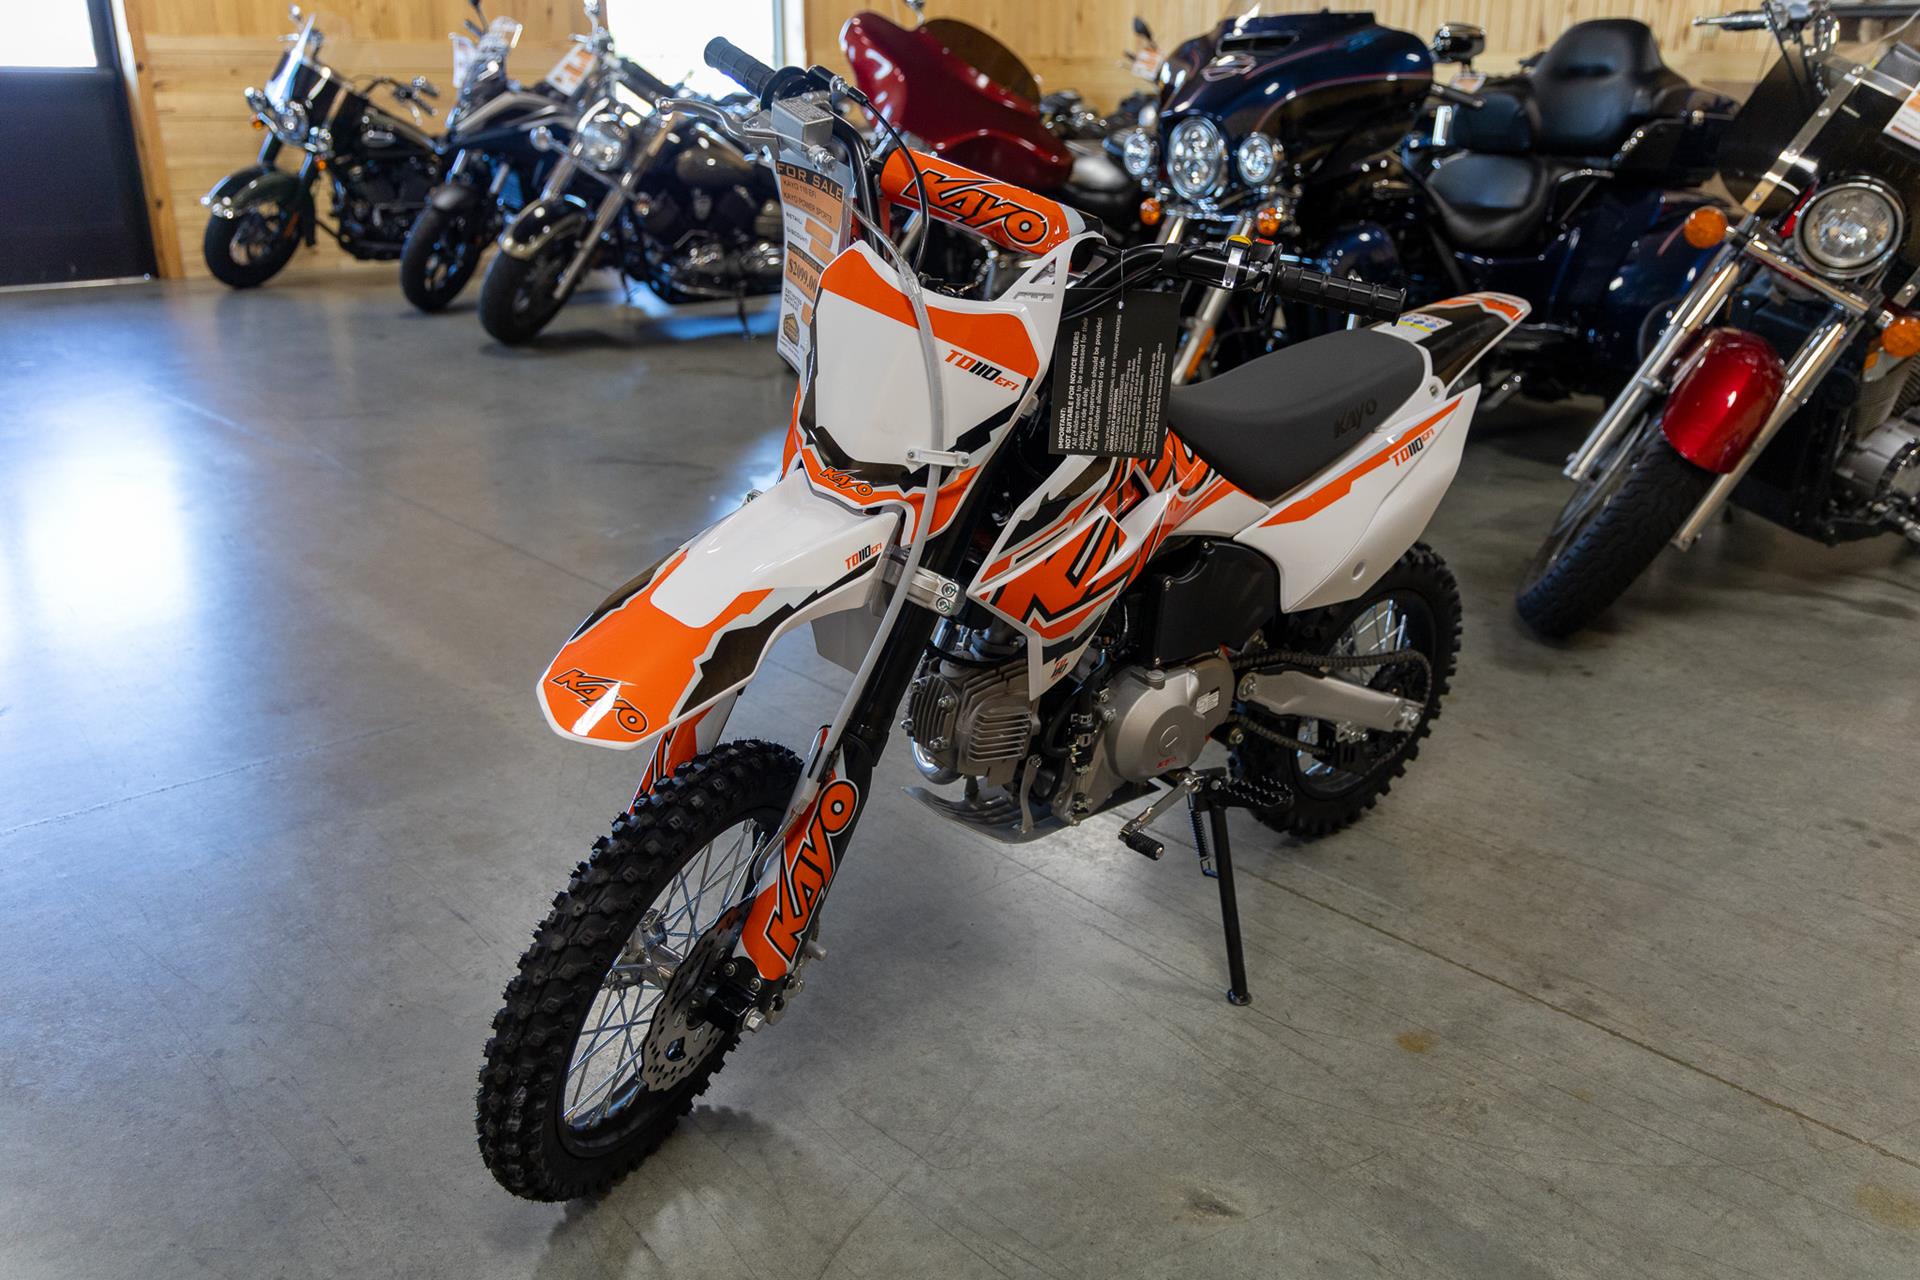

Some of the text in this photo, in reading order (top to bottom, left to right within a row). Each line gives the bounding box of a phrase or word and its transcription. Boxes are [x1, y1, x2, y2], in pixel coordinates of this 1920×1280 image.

[776, 163, 843, 201] FOR SALE
[902, 168, 1049, 247] KAYO
[1058, 408, 1067, 448] IMPORTANT:
[1334, 399, 1378, 439] KAYO
[818, 466, 874, 497] KAYO
[551, 668, 649, 734] KAYO
[764, 779, 859, 965] KAYO
